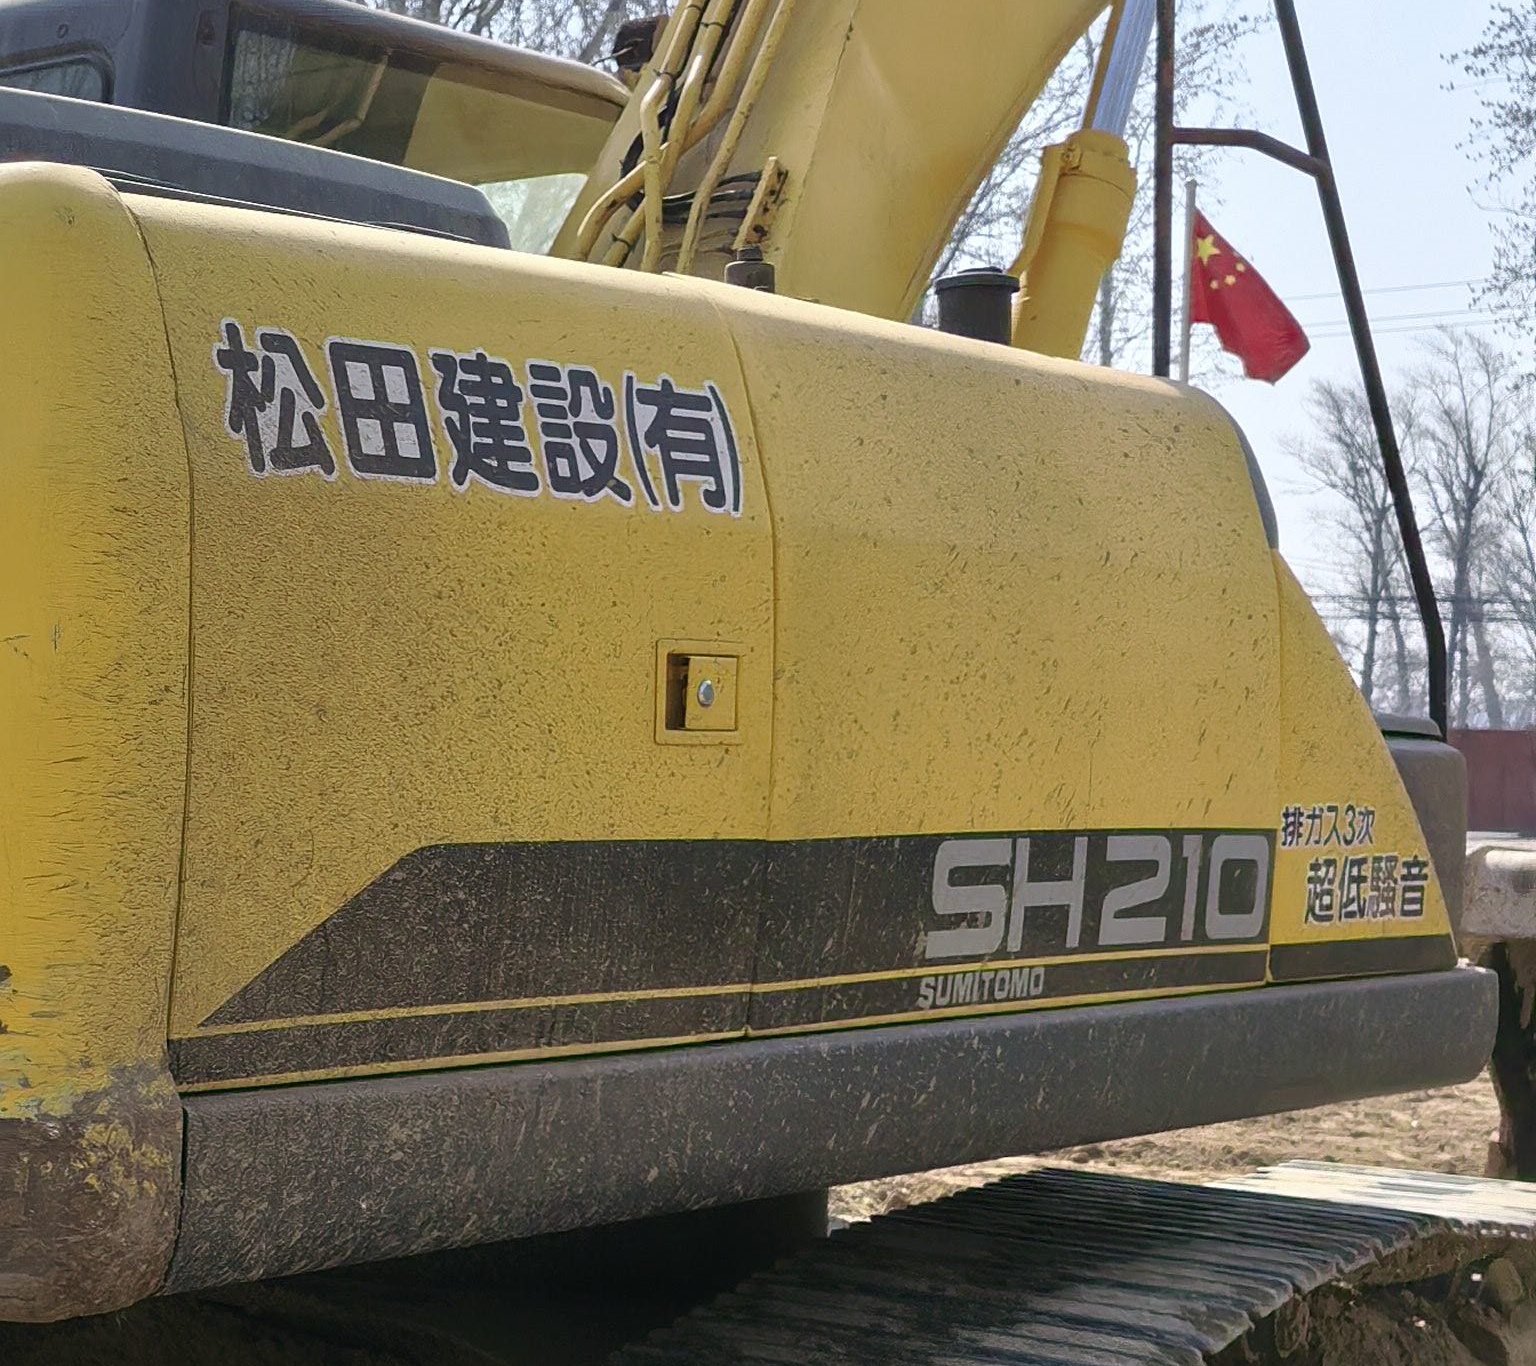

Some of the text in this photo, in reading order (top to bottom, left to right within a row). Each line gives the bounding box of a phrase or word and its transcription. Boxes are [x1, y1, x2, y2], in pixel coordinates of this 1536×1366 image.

[1281, 803, 1376, 847] 排ガス3次
[925, 834, 1270, 959] SH210
[916, 966, 1046, 1010] SUMITOMO
